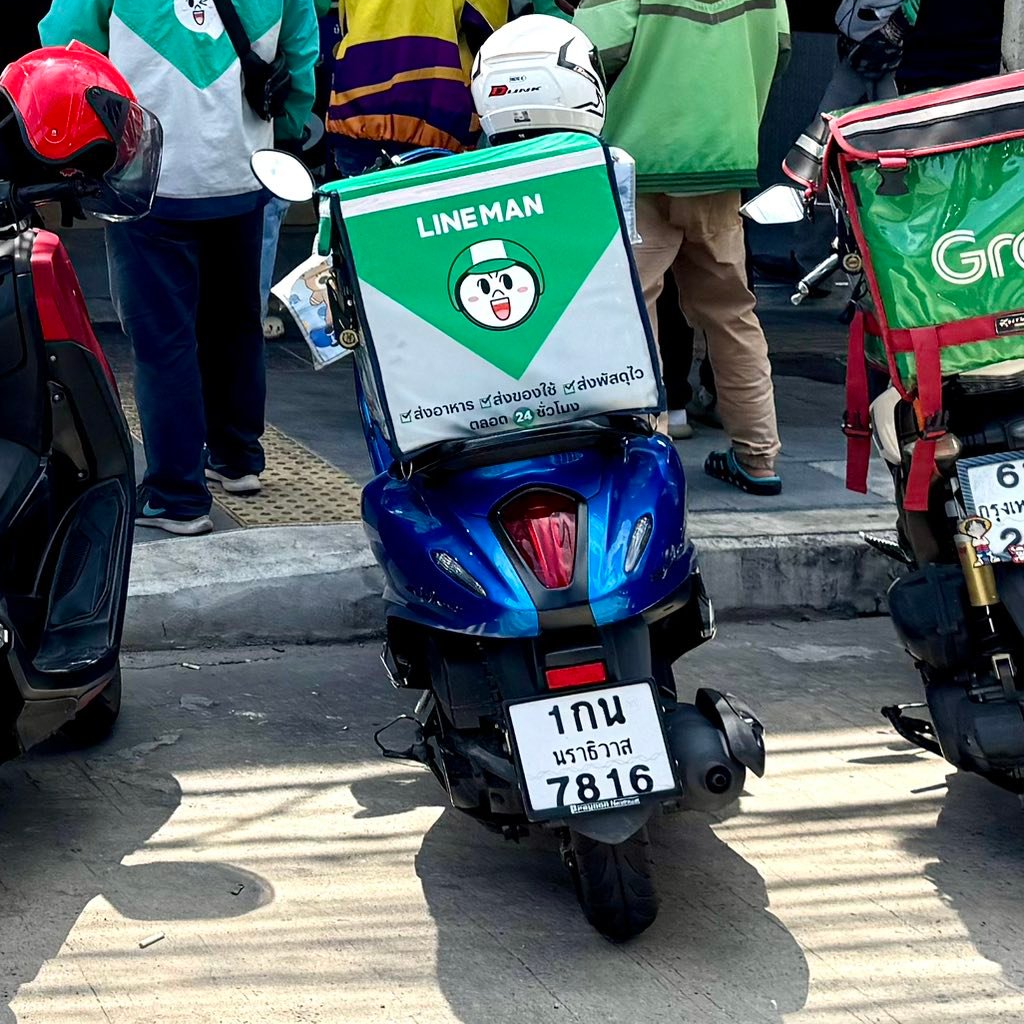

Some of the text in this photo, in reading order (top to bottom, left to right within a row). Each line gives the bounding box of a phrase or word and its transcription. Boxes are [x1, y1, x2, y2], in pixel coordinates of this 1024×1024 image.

[931, 229, 1024, 285] Gr
[412, 365, 645, 420] ส่งอาหาร ส่งของใช้ ส่งพัสดุไว
[469, 399, 580, 431] ตลอด 24 ชั่วโมง
[996, 463, 1024, 488] 6
[548, 694, 627, 735] 1กน
[552, 737, 633, 766] นราธิวาส
[546, 764, 654, 808] 7816
